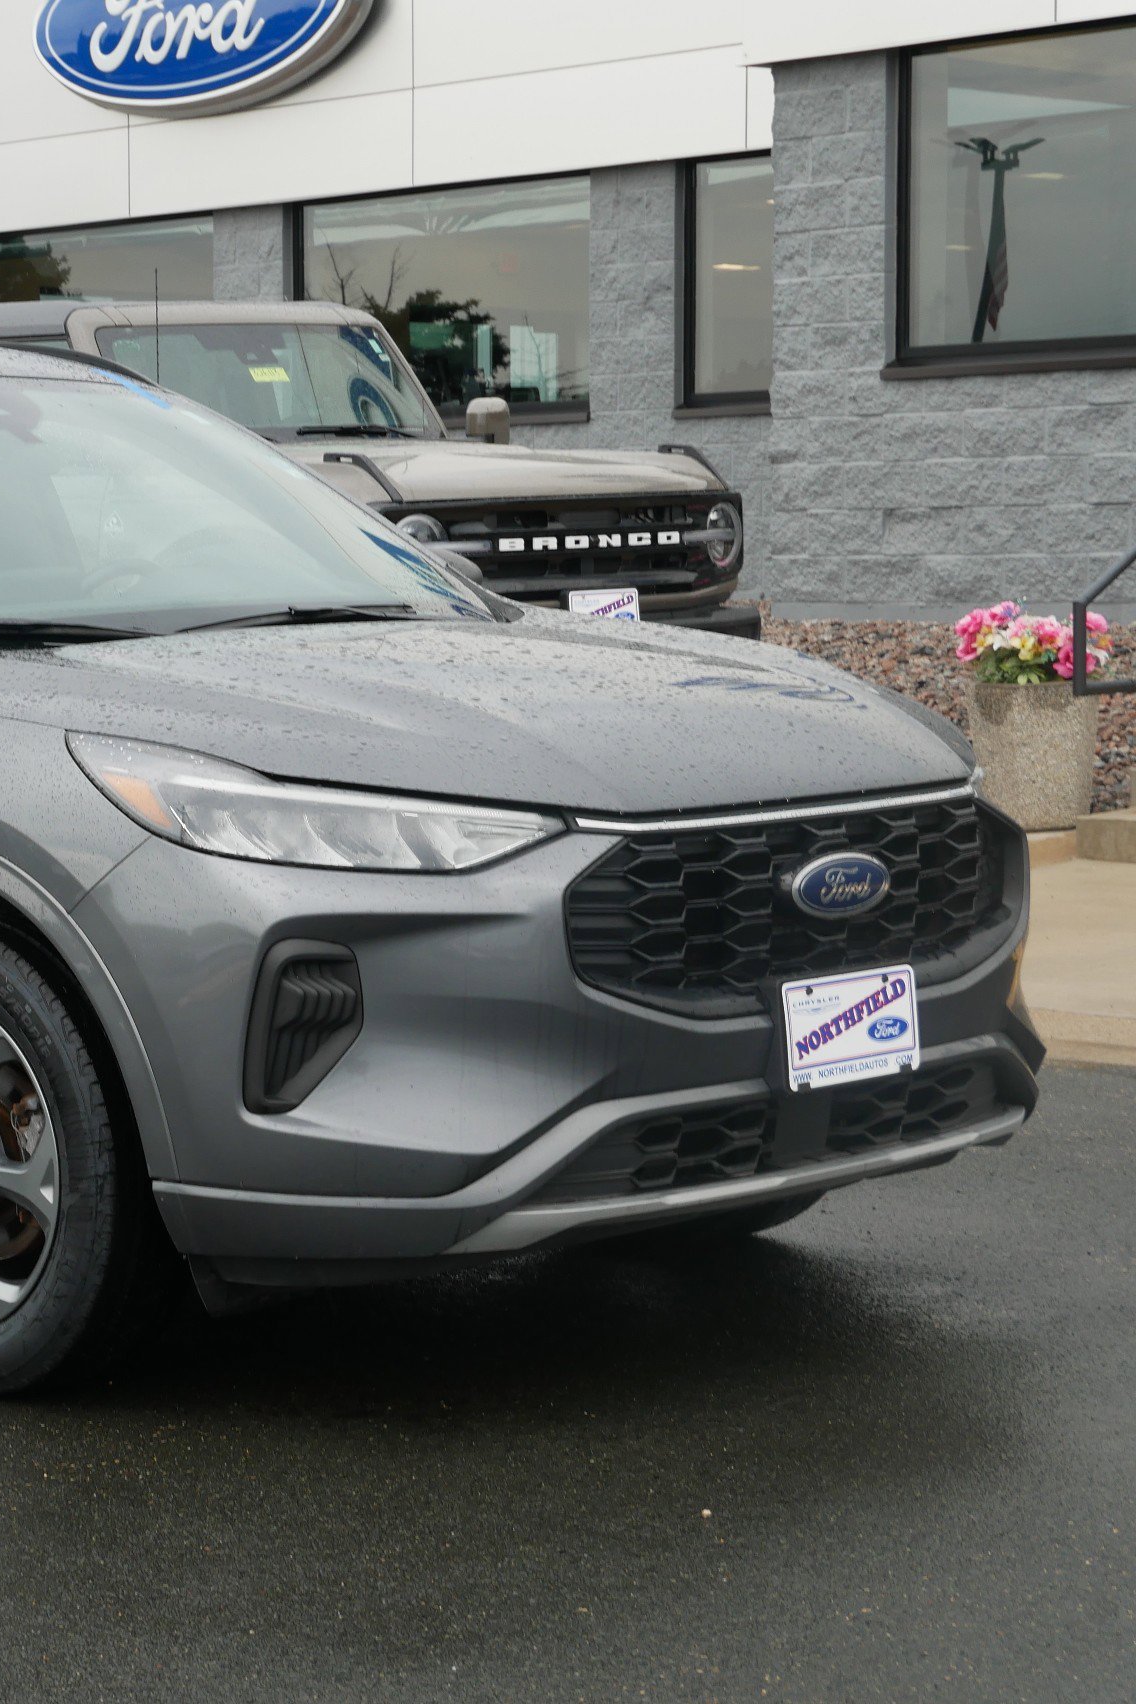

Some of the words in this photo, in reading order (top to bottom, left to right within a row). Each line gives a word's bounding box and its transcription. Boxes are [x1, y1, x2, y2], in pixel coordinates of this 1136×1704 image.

[90, 0, 264, 72] Ford
[499, 531, 680, 551] BRONCO
[821, 867, 872, 904] Ford
[795, 978, 906, 1060] NORTHFIELD
[875, 1018, 902, 1039] Ford
[818, 1058, 889, 1078] NORTHFIELDAUTOS
